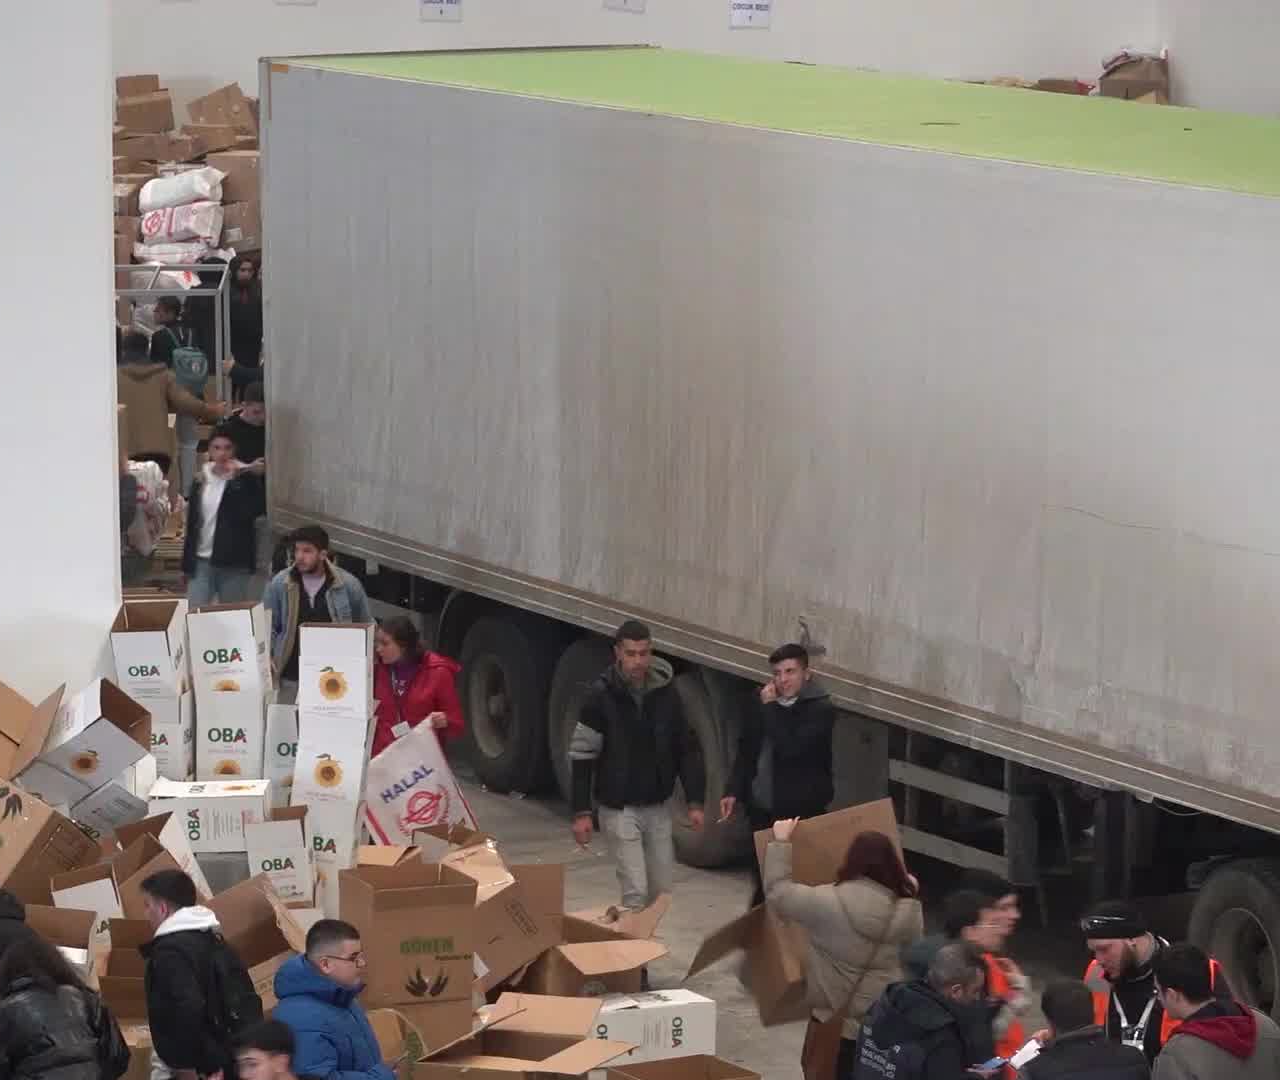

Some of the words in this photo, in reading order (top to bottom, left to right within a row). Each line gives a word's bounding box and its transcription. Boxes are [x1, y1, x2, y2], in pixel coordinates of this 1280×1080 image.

[203, 648, 243, 664] OBA
[128, 665, 161, 677] OBA
[150, 733, 169, 746] BA
[207, 727, 247, 743] OBA
[380, 764, 435, 804] HALAL
[187, 808, 201, 842] OBA
[312, 835, 337, 855] BA
[261, 856, 295, 873] OBA
[671, 1016, 683, 1048] OBA
